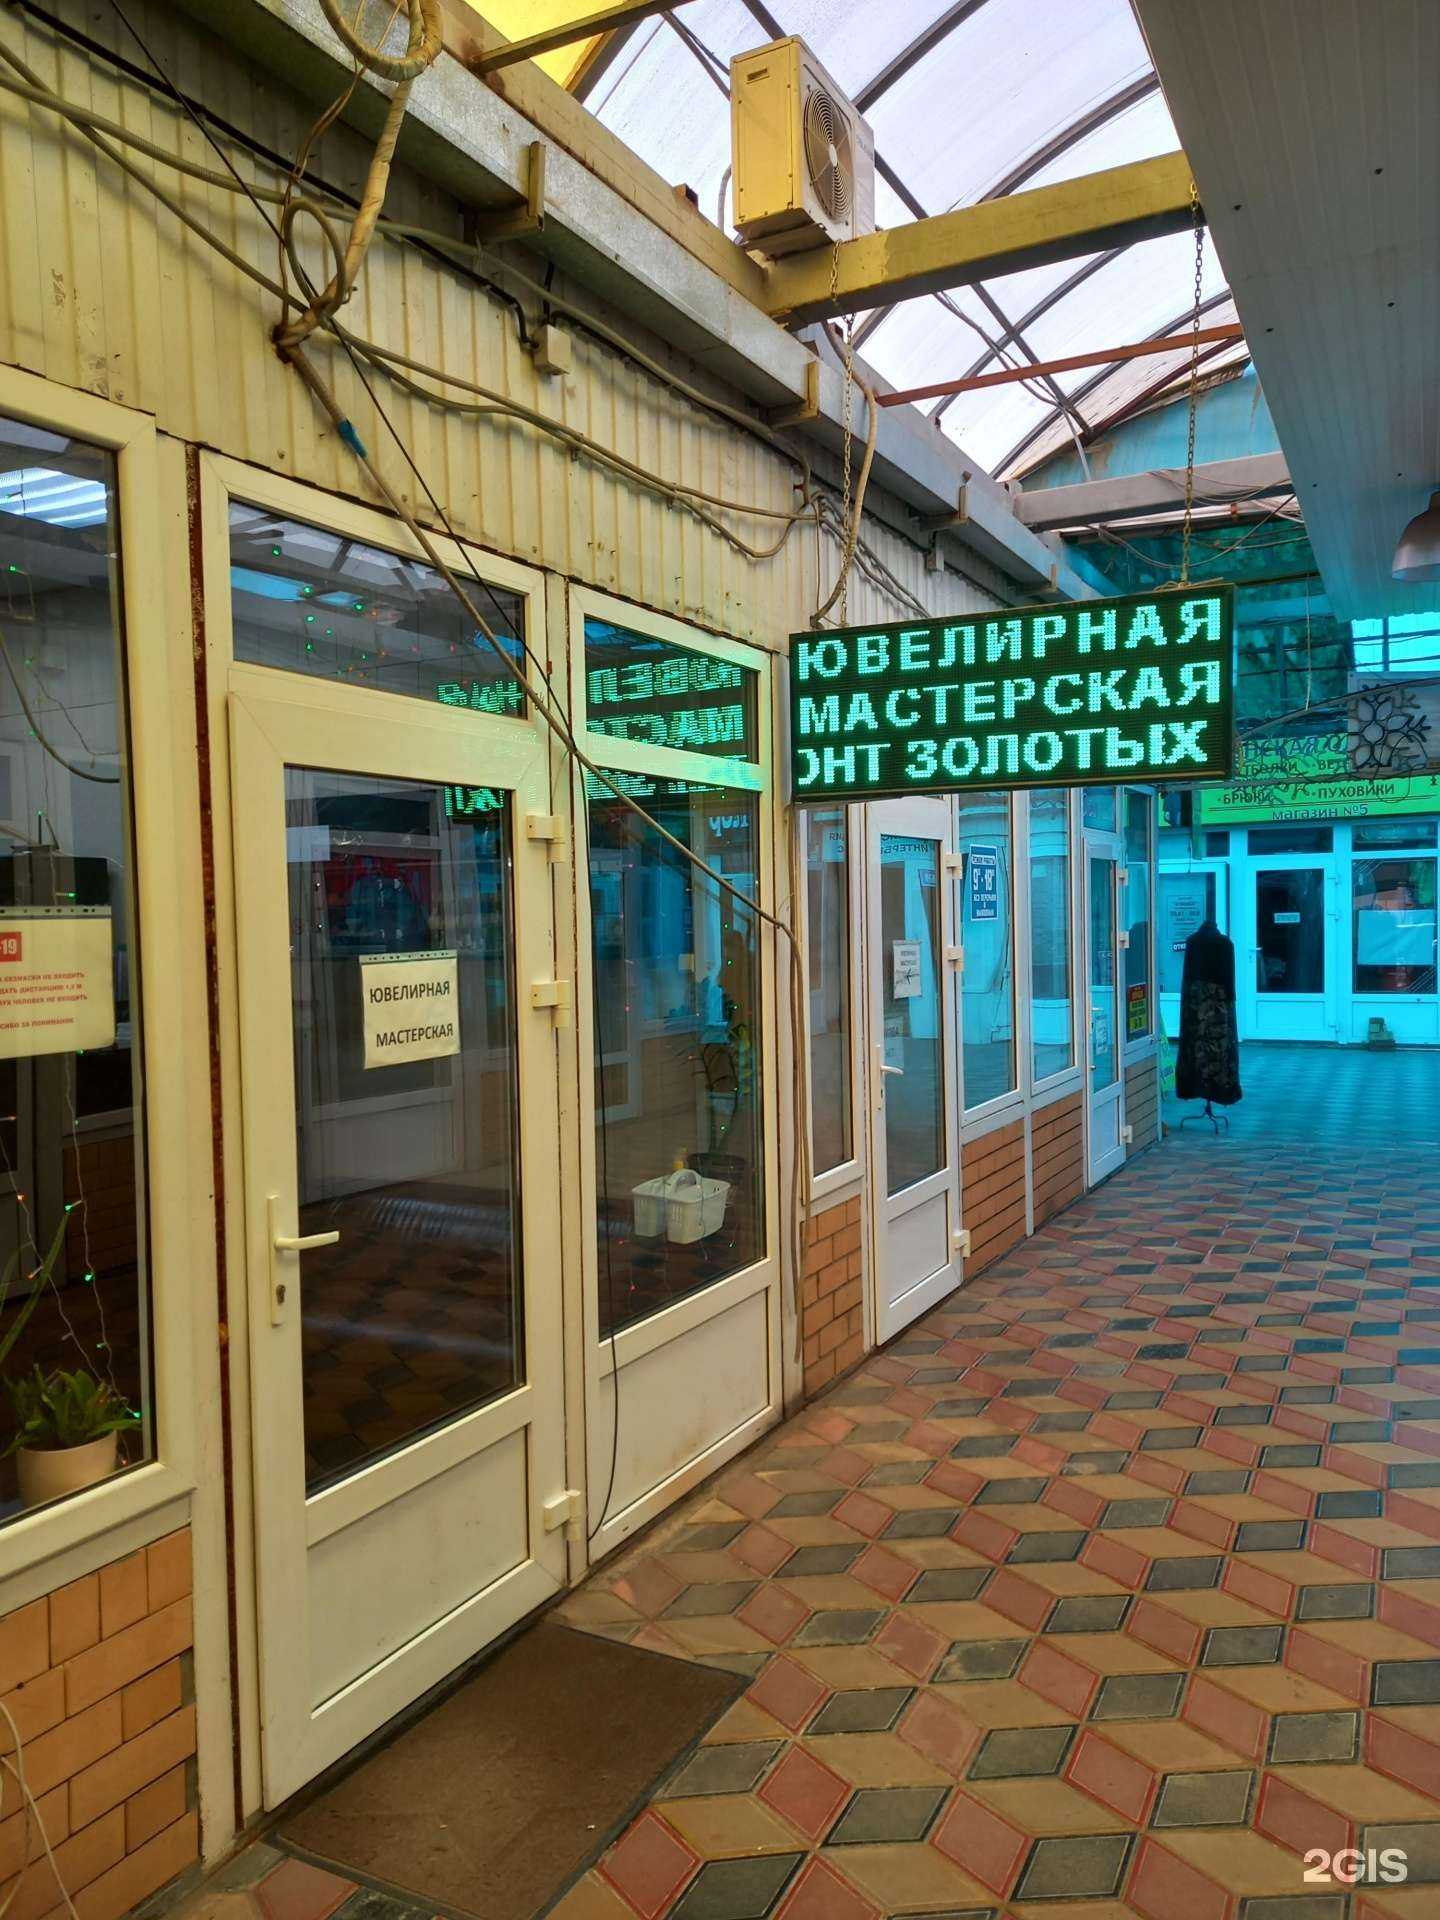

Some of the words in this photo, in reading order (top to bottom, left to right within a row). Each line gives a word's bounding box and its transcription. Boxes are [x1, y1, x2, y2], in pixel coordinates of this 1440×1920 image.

[798, 598, 1221, 680] ЮВЕЛИРНАЯ
[799, 660, 1221, 735] МАСТЕРСКАЯ
[906, 720, 1208, 779] ЗОЛОТЫХ
[1318, 784, 1395, 799] ПУХОВИКИ
[1272, 807, 1338, 820] магазин
[370, 980, 451, 1004] ЮВЕЛИРНАЯ
[376, 1023, 454, 1048] МАСТЕРСКАЯ
